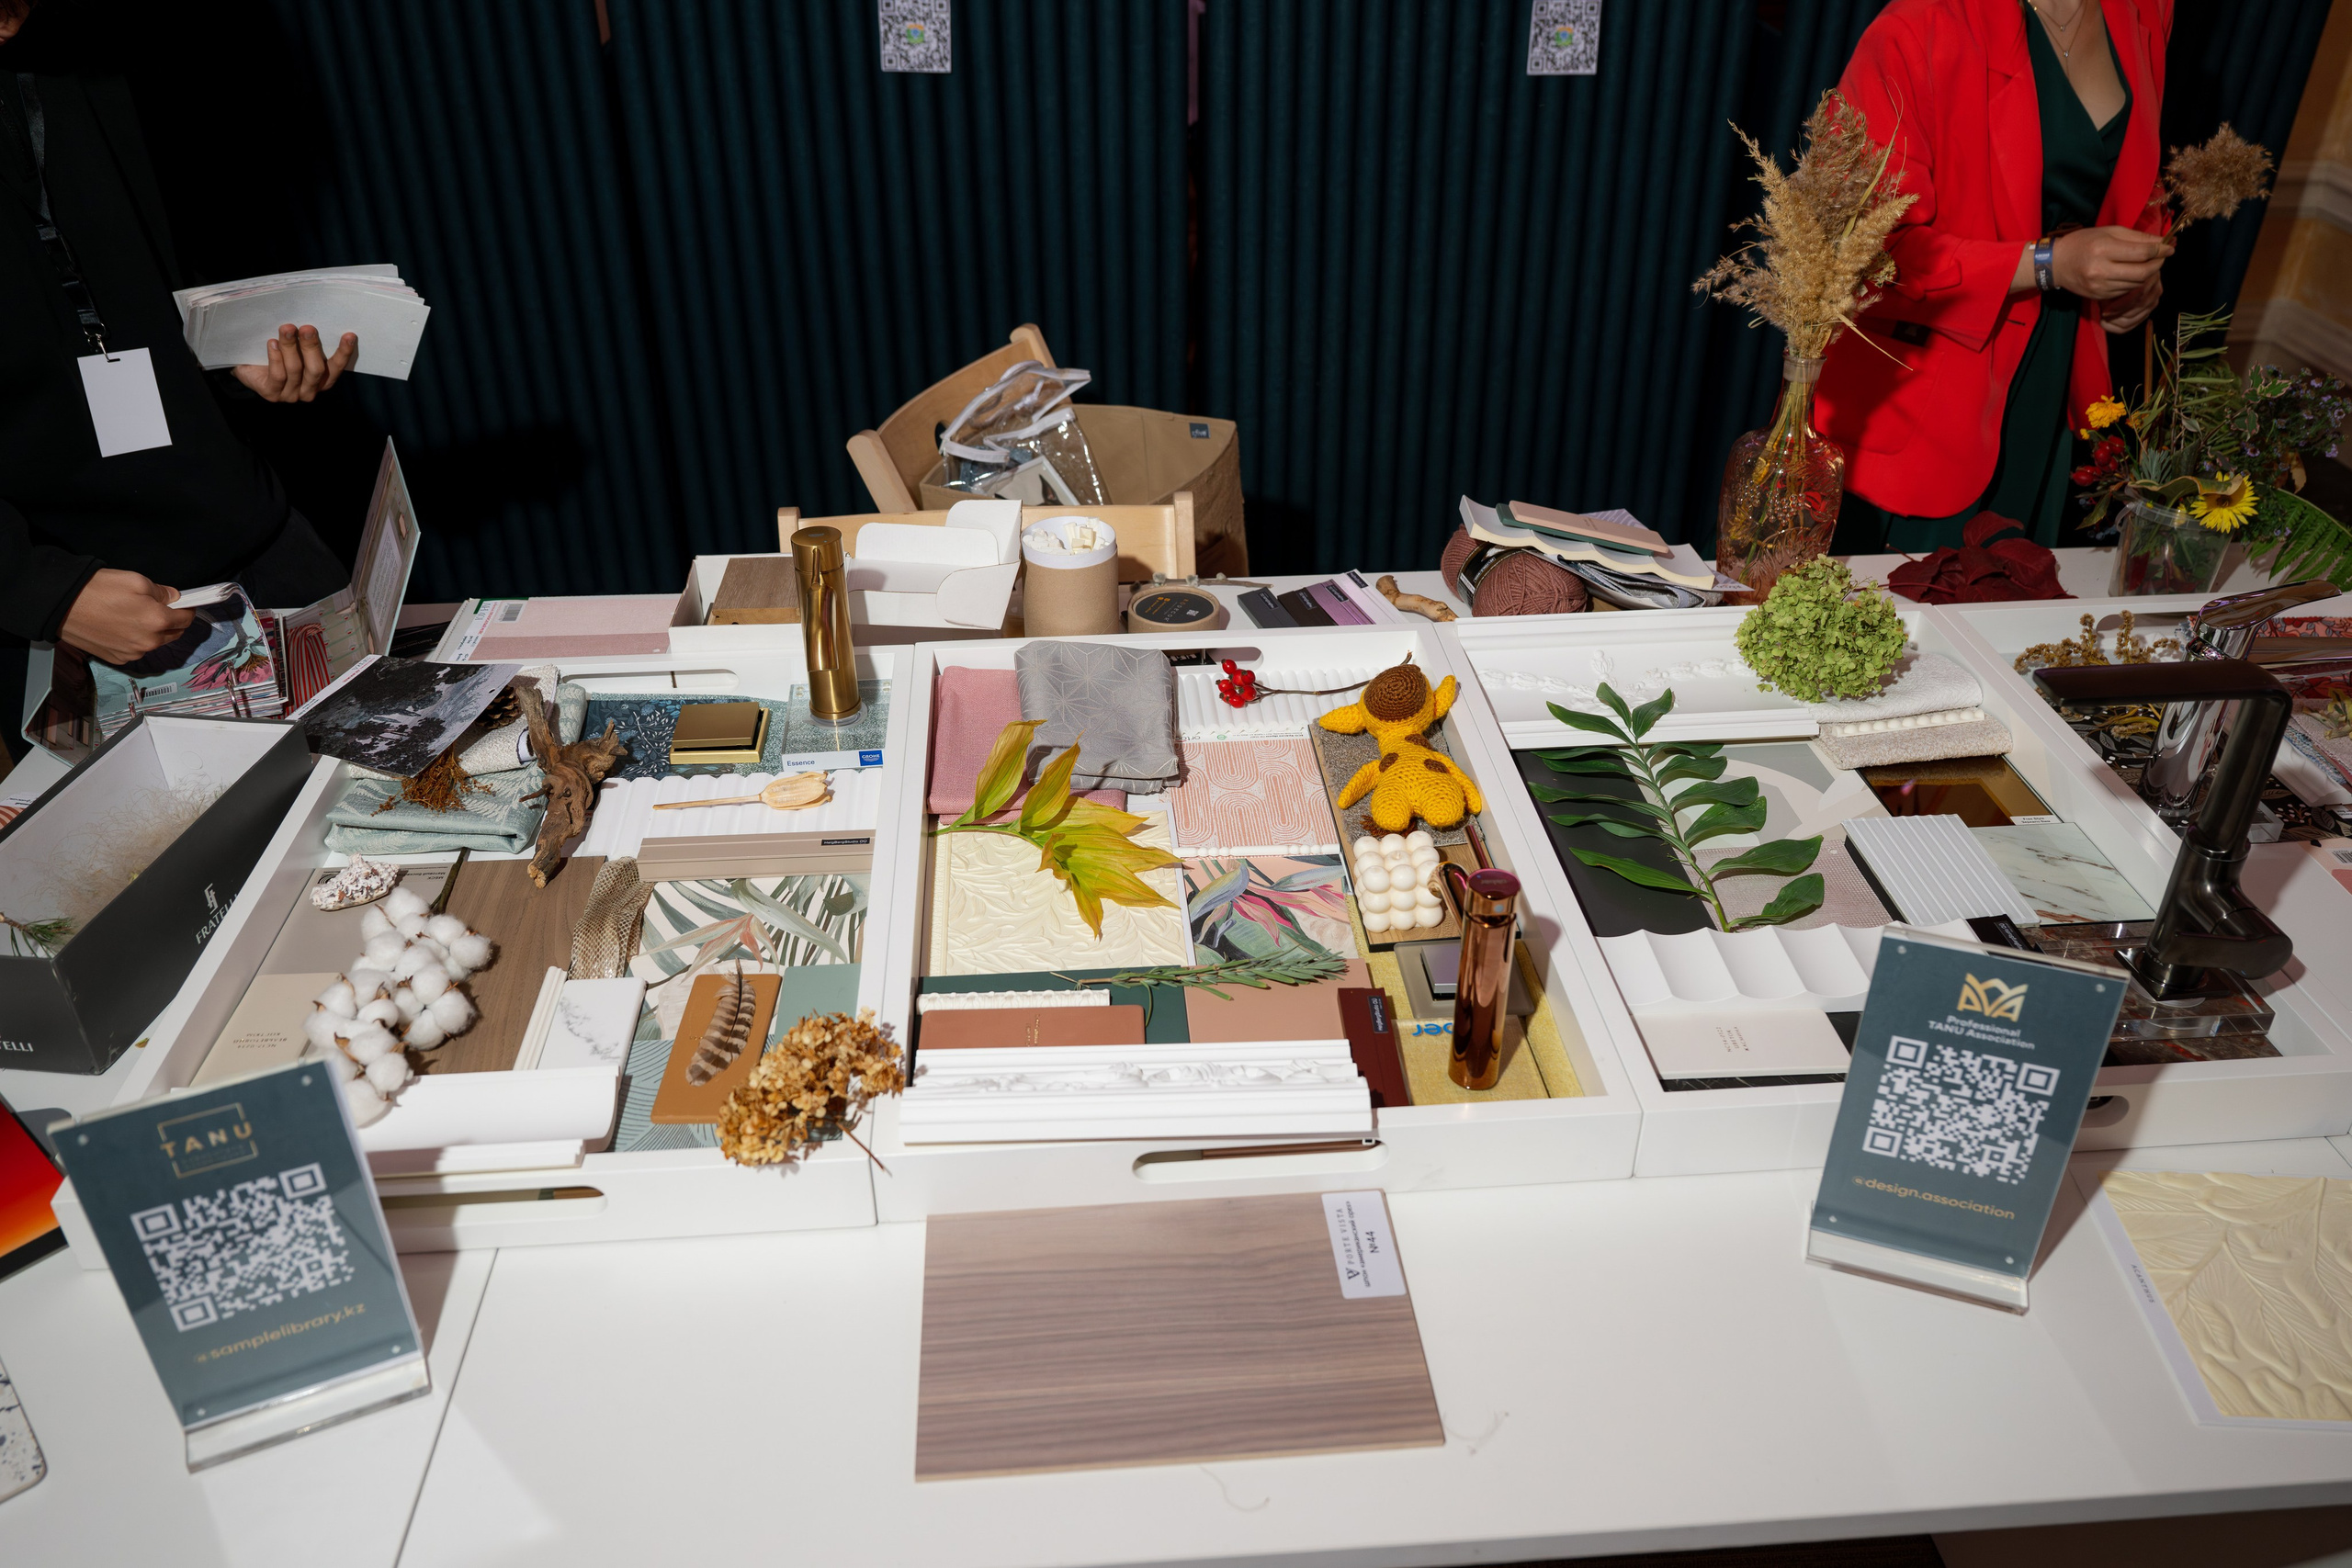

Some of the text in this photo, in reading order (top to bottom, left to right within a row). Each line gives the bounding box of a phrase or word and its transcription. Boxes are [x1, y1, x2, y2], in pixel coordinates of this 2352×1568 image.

[1928, 1020, 2035, 1050] TANU Association
[1947, 1014, 2021, 1038] Professional
[161, 1122, 253, 1158] TANU
[1336, 1208, 1355, 1266] PORTE VISTA
